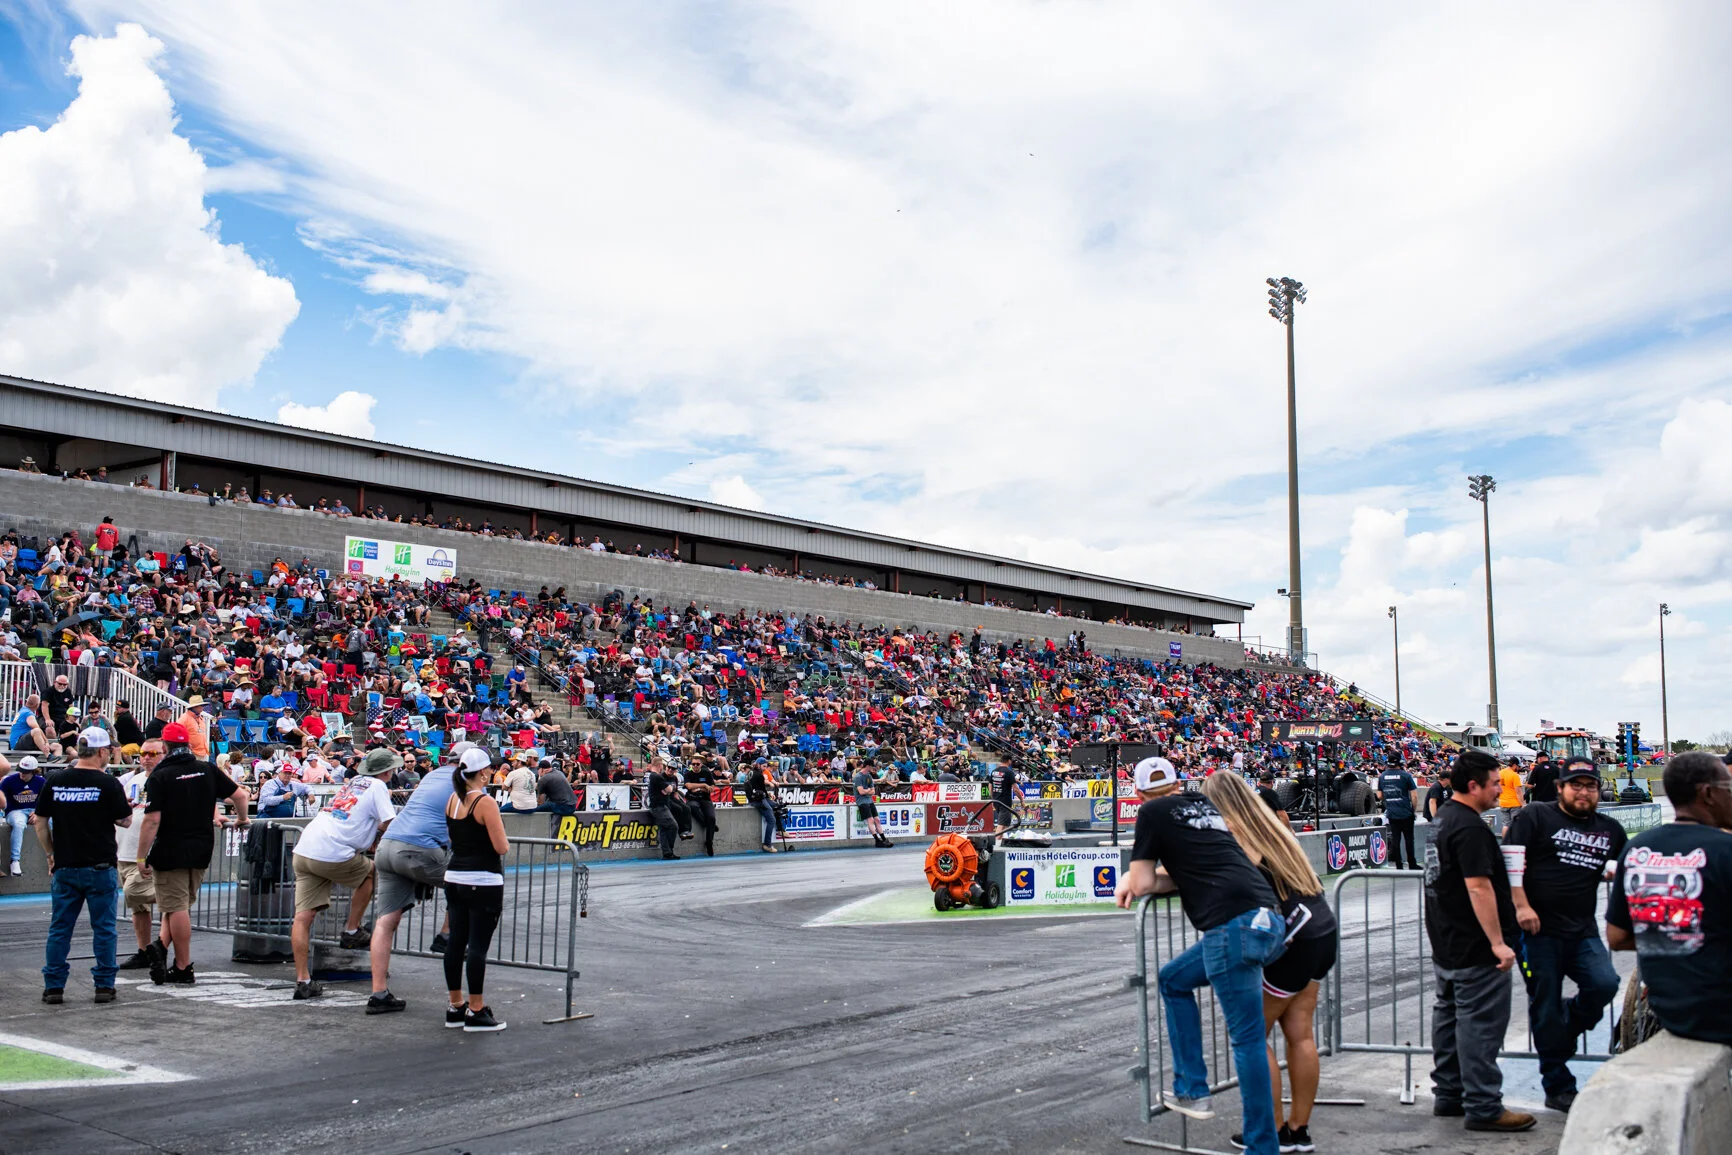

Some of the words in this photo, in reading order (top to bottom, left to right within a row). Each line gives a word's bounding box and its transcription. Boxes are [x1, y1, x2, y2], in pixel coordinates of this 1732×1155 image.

[386, 565, 411, 577] Holiday
[411, 569, 421, 577] Inn
[946, 784, 976, 792] PRECISION
[779, 787, 814, 805] Holley
[880, 792, 912, 800] FuelTech
[785, 809, 834, 830] trange
[939, 819, 979, 832] PERFORMNCE
[1348, 835, 1367, 847] MAKIN'
[1551, 828, 1611, 850] ANIMAL
[1008, 851, 1119, 861] WilliamsHotelGroup.com
[1348, 849, 1368, 861] POWER!
[1647, 854, 1703, 867] Fireball
[1045, 890, 1074, 900] Holiday
[1075, 890, 1087, 899] Inn
